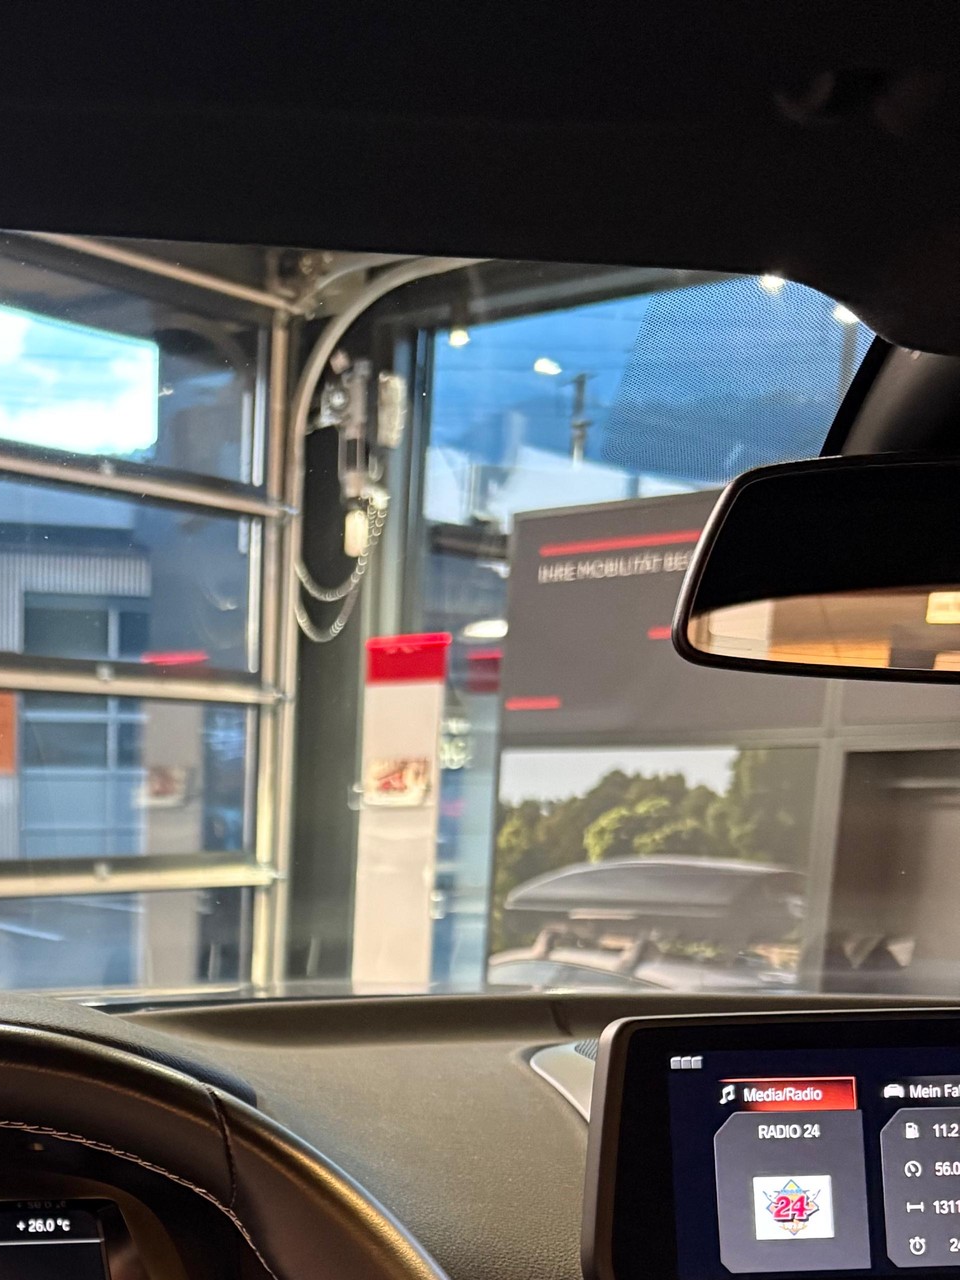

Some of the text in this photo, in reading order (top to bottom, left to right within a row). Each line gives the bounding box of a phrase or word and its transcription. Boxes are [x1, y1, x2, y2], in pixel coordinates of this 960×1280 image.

[538, 563, 576, 584] IHRE
[744, 1087, 822, 1103] Media/Radio
[909, 1083, 960, 1099] Mein Fa
[758, 1123, 821, 1140] RADIO 24
[774, 1195, 807, 1219] 24
